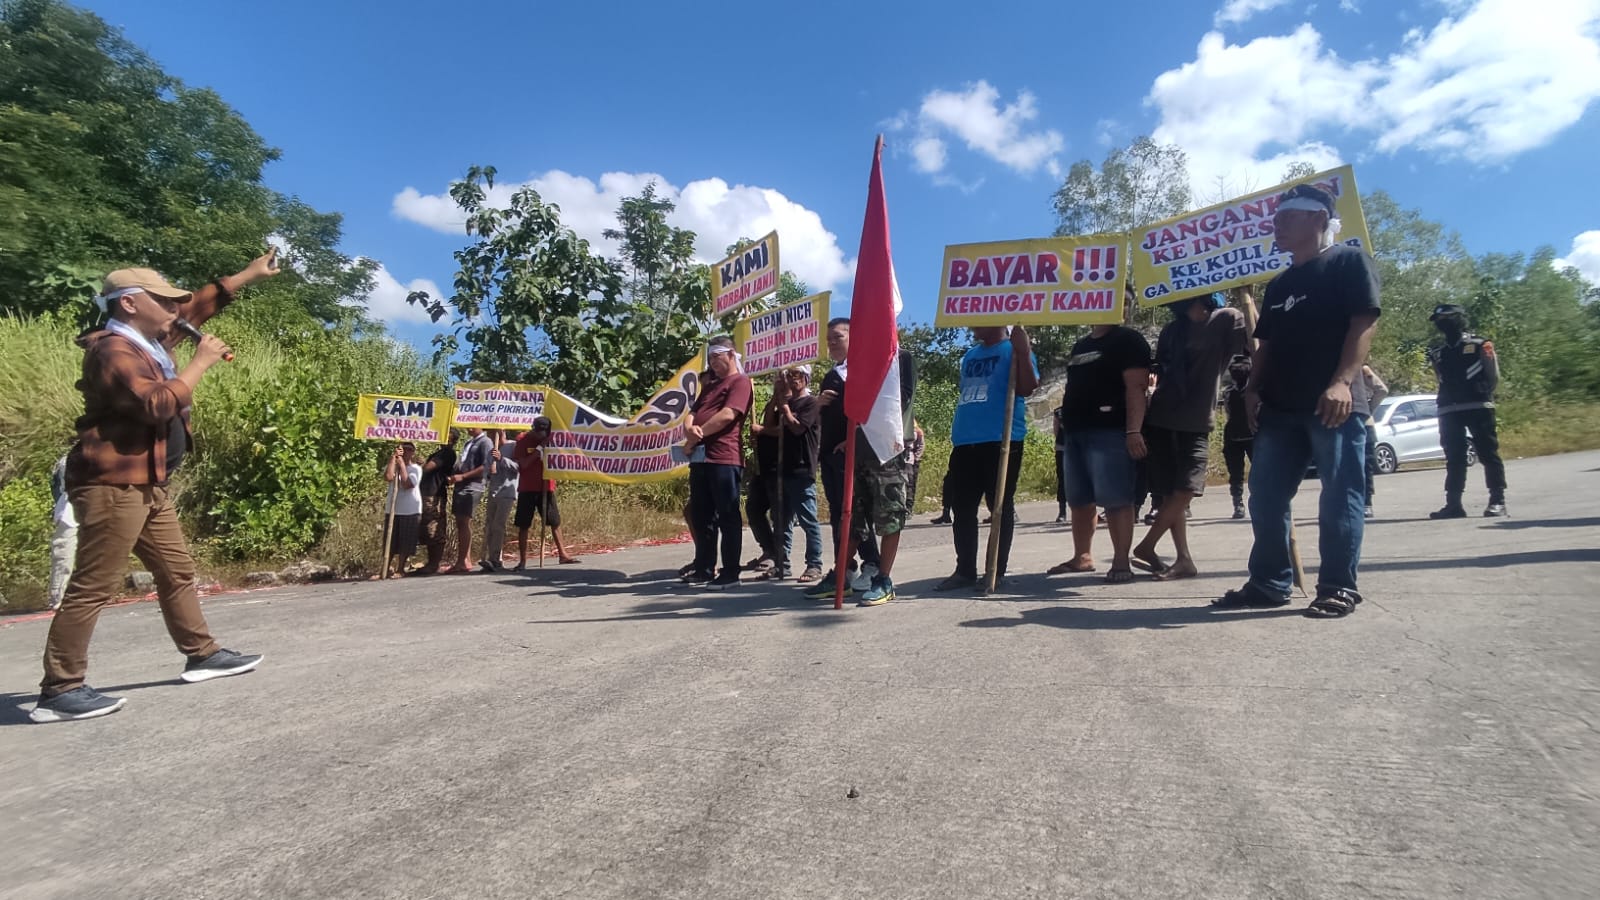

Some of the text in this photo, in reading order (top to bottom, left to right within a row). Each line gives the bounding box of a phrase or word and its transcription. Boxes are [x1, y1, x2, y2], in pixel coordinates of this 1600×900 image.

[1142, 177, 1340, 250] JANGANKN
[1153, 243, 1188, 264] KE
[1193, 220, 1275, 255] INVES
[721, 241, 769, 288] KAMI
[949, 247, 1117, 288] BAYAR !!!
[1144, 283, 1169, 298] GA
[1172, 258, 1280, 291] TANGGUNG
[1171, 263, 1202, 278] KE
[1206, 245, 1263, 272] KULI
[717, 268, 775, 313] KORBAN JANJI
[945, 290, 1113, 314] KERINGAT KAMI
[751, 302, 812, 336] KAPAN NICH
[745, 321, 818, 357] TAGIHAN KAMI
[744, 342, 818, 374] AKAN DIBAYAR
[376, 399, 434, 418] KAMI
[456, 390, 545, 403] BOS TUMIYANA
[460, 403, 542, 414] TOLONG PIKIRKAN
[378, 417, 430, 429] KORBAN
[456, 414, 494, 422] KERINGAT
[495, 415, 520, 423] KERJA
[620, 430, 671, 452] MANDOR
